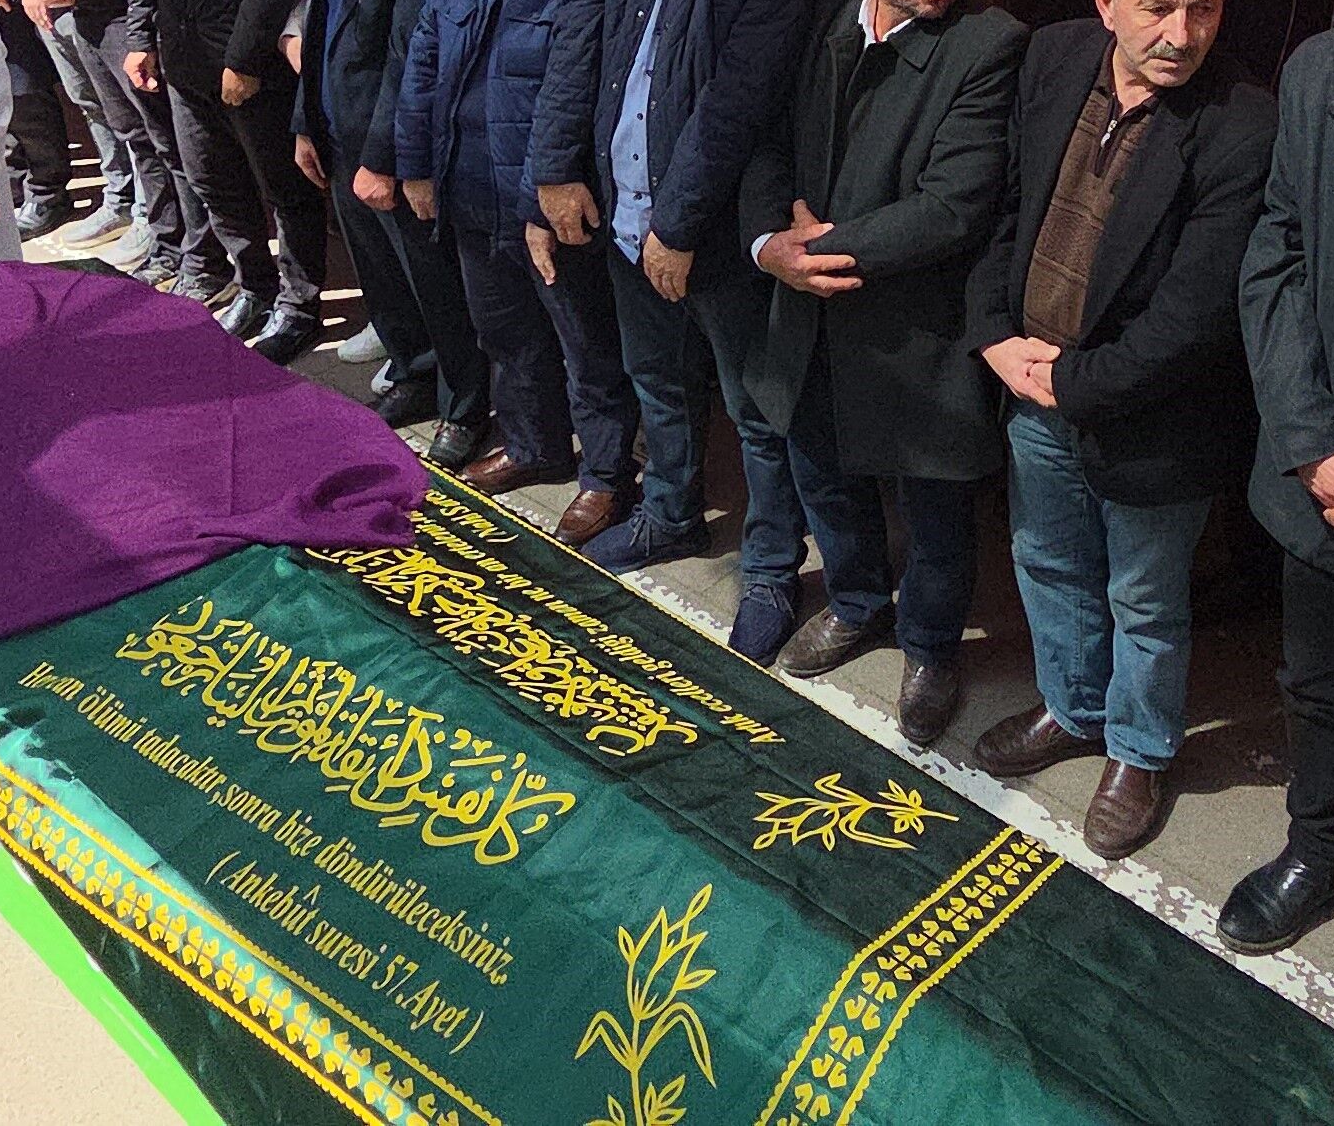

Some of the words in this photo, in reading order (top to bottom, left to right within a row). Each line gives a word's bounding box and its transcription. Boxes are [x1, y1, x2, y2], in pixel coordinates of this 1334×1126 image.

[477, 557, 508, 571] an
[495, 574, 533, 590] bir
[522, 587, 554, 602] ne
[545, 600, 609, 634] zaman
[77, 685, 149, 743] ölümü
[274, 809, 323, 857] bize
[306, 920, 388, 980] suresi
